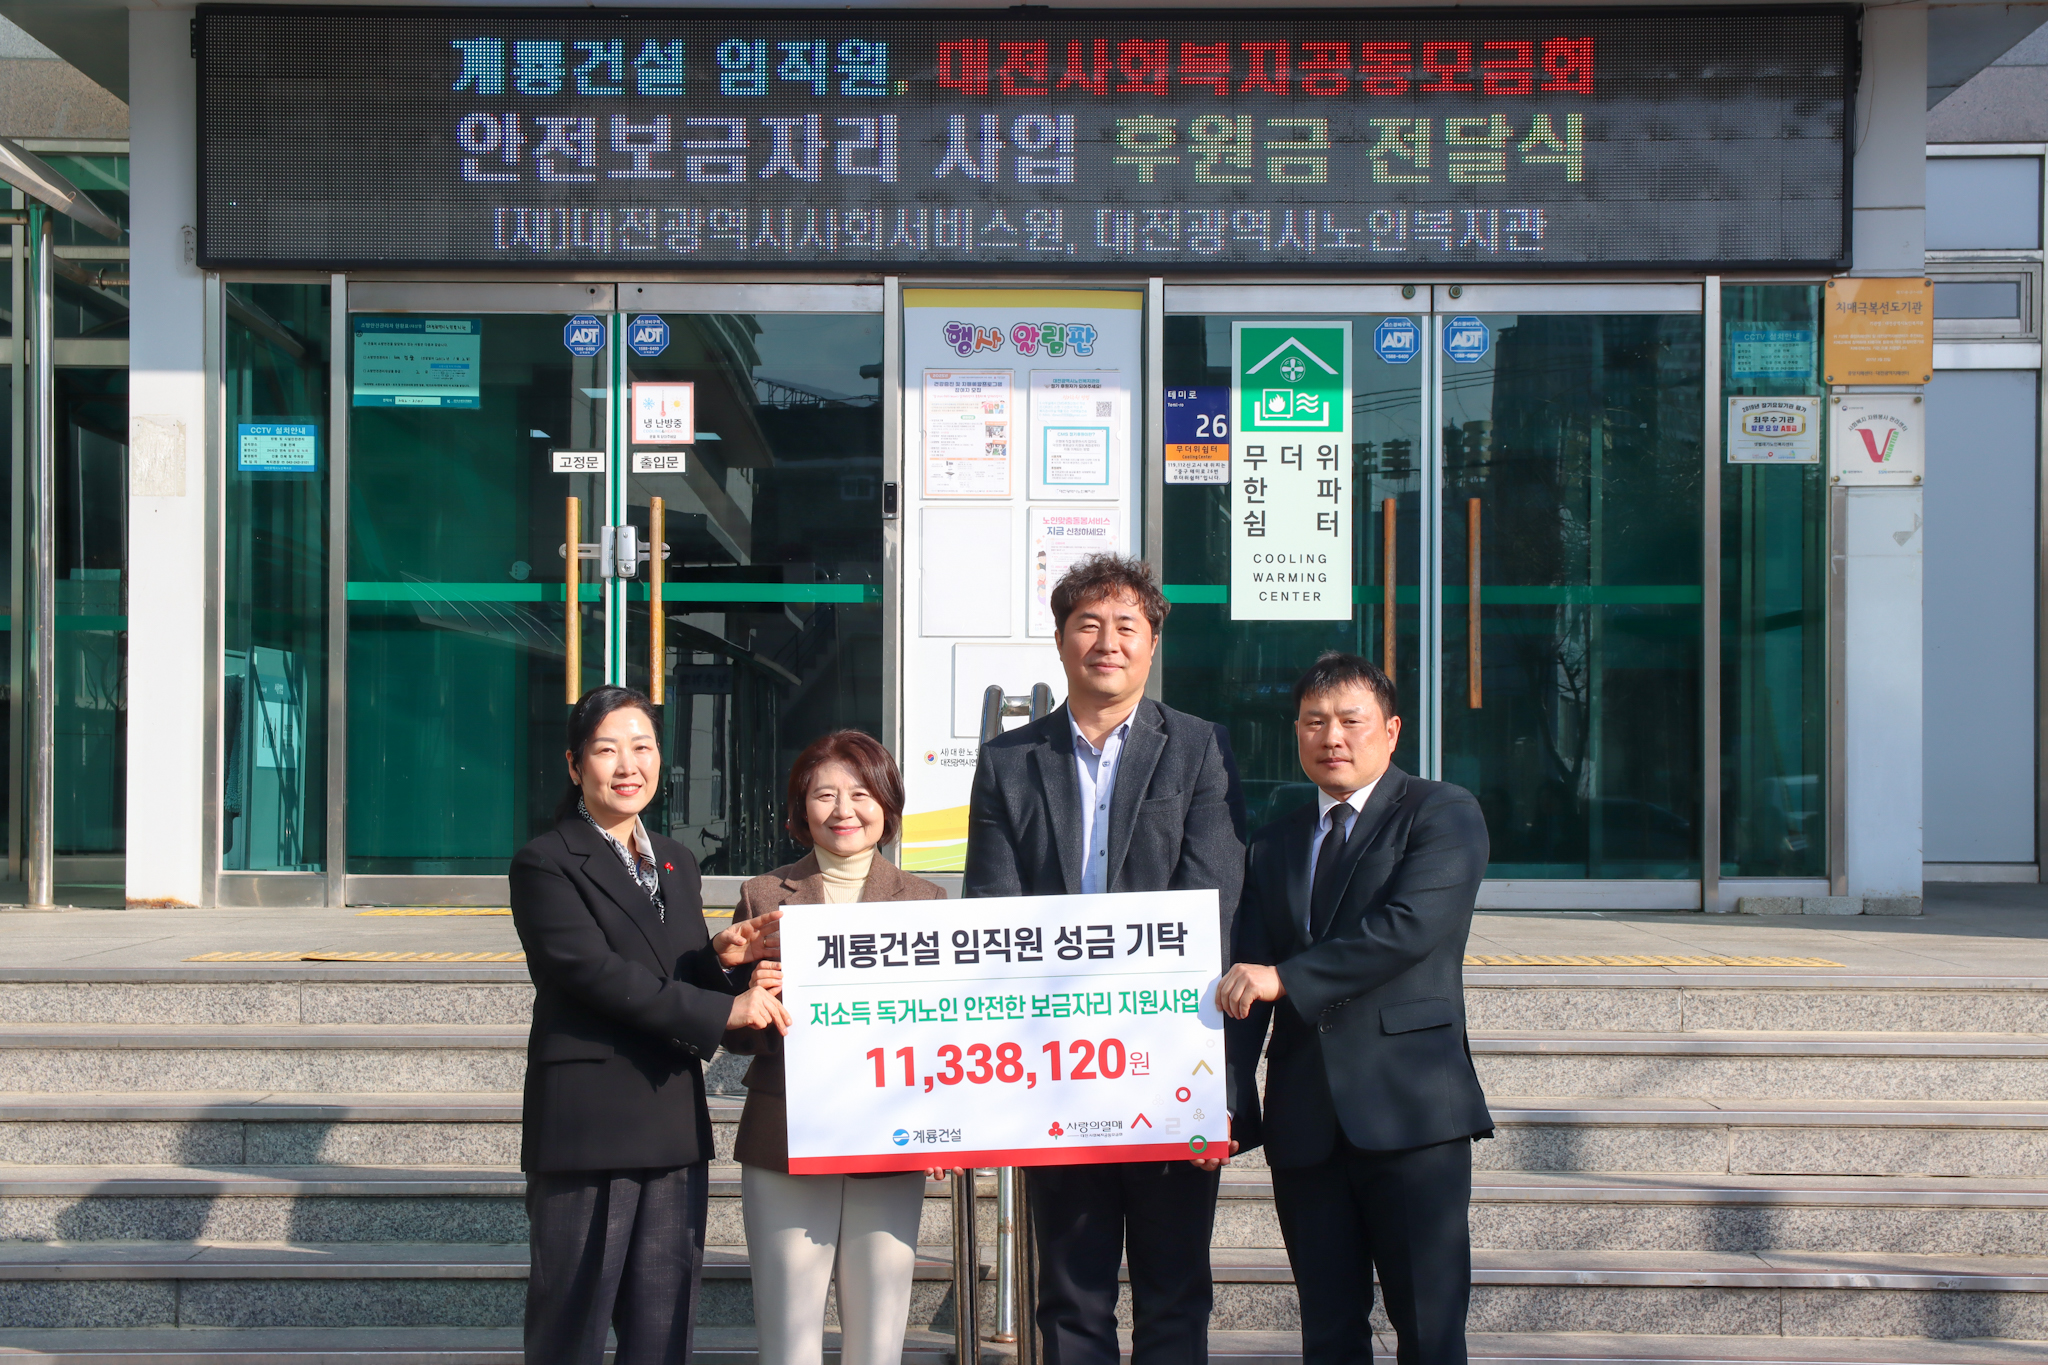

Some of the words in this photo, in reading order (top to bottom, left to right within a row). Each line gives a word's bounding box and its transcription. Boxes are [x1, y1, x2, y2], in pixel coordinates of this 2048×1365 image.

[449, 37, 686, 95] 계룡건설
[936, 37, 1595, 96] 대전사회복지공동모금회
[456, 113, 901, 183] 안전보금자리
[932, 114, 1077, 183] 사업
[1112, 114, 1331, 183] 후원금
[1366, 113, 1585, 183] 전달식
[1093, 208, 1548, 254] 대전광역시노인복지관
[1836, 301, 1923, 315] 치매극복선도기관
[570, 328, 600, 343] ADT
[634, 328, 664, 343] ADT
[944, 321, 1004, 357] 행사
[1011, 322, 1097, 357] 알림판
[1381, 331, 1414, 348] ADT
[1450, 330, 1483, 347] ADT
[1769, 332, 1800, 340] 설치안내
[1167, 390, 1197, 399] 테미로
[643, 418, 652, 428] 냉
[655, 418, 682, 428] 난방중
[1196, 414, 1228, 438] 26
[275, 426, 306, 435] 설치안내
[1176, 445, 1218, 454] 무더위쉼터
[559, 456, 599, 469] 고정문
[640, 456, 679, 469] 출입문
[1043, 517, 1111, 525] 노인맞춤돌봄서비스
[1047, 526, 1064, 535] 지금
[1066, 528, 1106, 536] 신청하세요!
[1253, 553, 1327, 564] COOLING
[1253, 572, 1327, 583] WARMING
[1259, 591, 1321, 601] CENTER
[817, 930, 940, 969] 계룡건설
[951, 926, 1043, 964] 임직원
[1054, 924, 1115, 961] 성금
[1126, 921, 1188, 957] 기탁
[810, 1001, 871, 1027] 저소득
[876, 997, 958, 1024] 독거노인
[964, 994, 1026, 1021] 안전한
[1031, 991, 1112, 1018] 보금자리
[1118, 988, 1199, 1015] 지원사업
[866, 1038, 1150, 1094] 11,338,120원
[1066, 1120, 1123, 1133] 사랑의열매
[912, 1127, 962, 1144] 계룡건설
